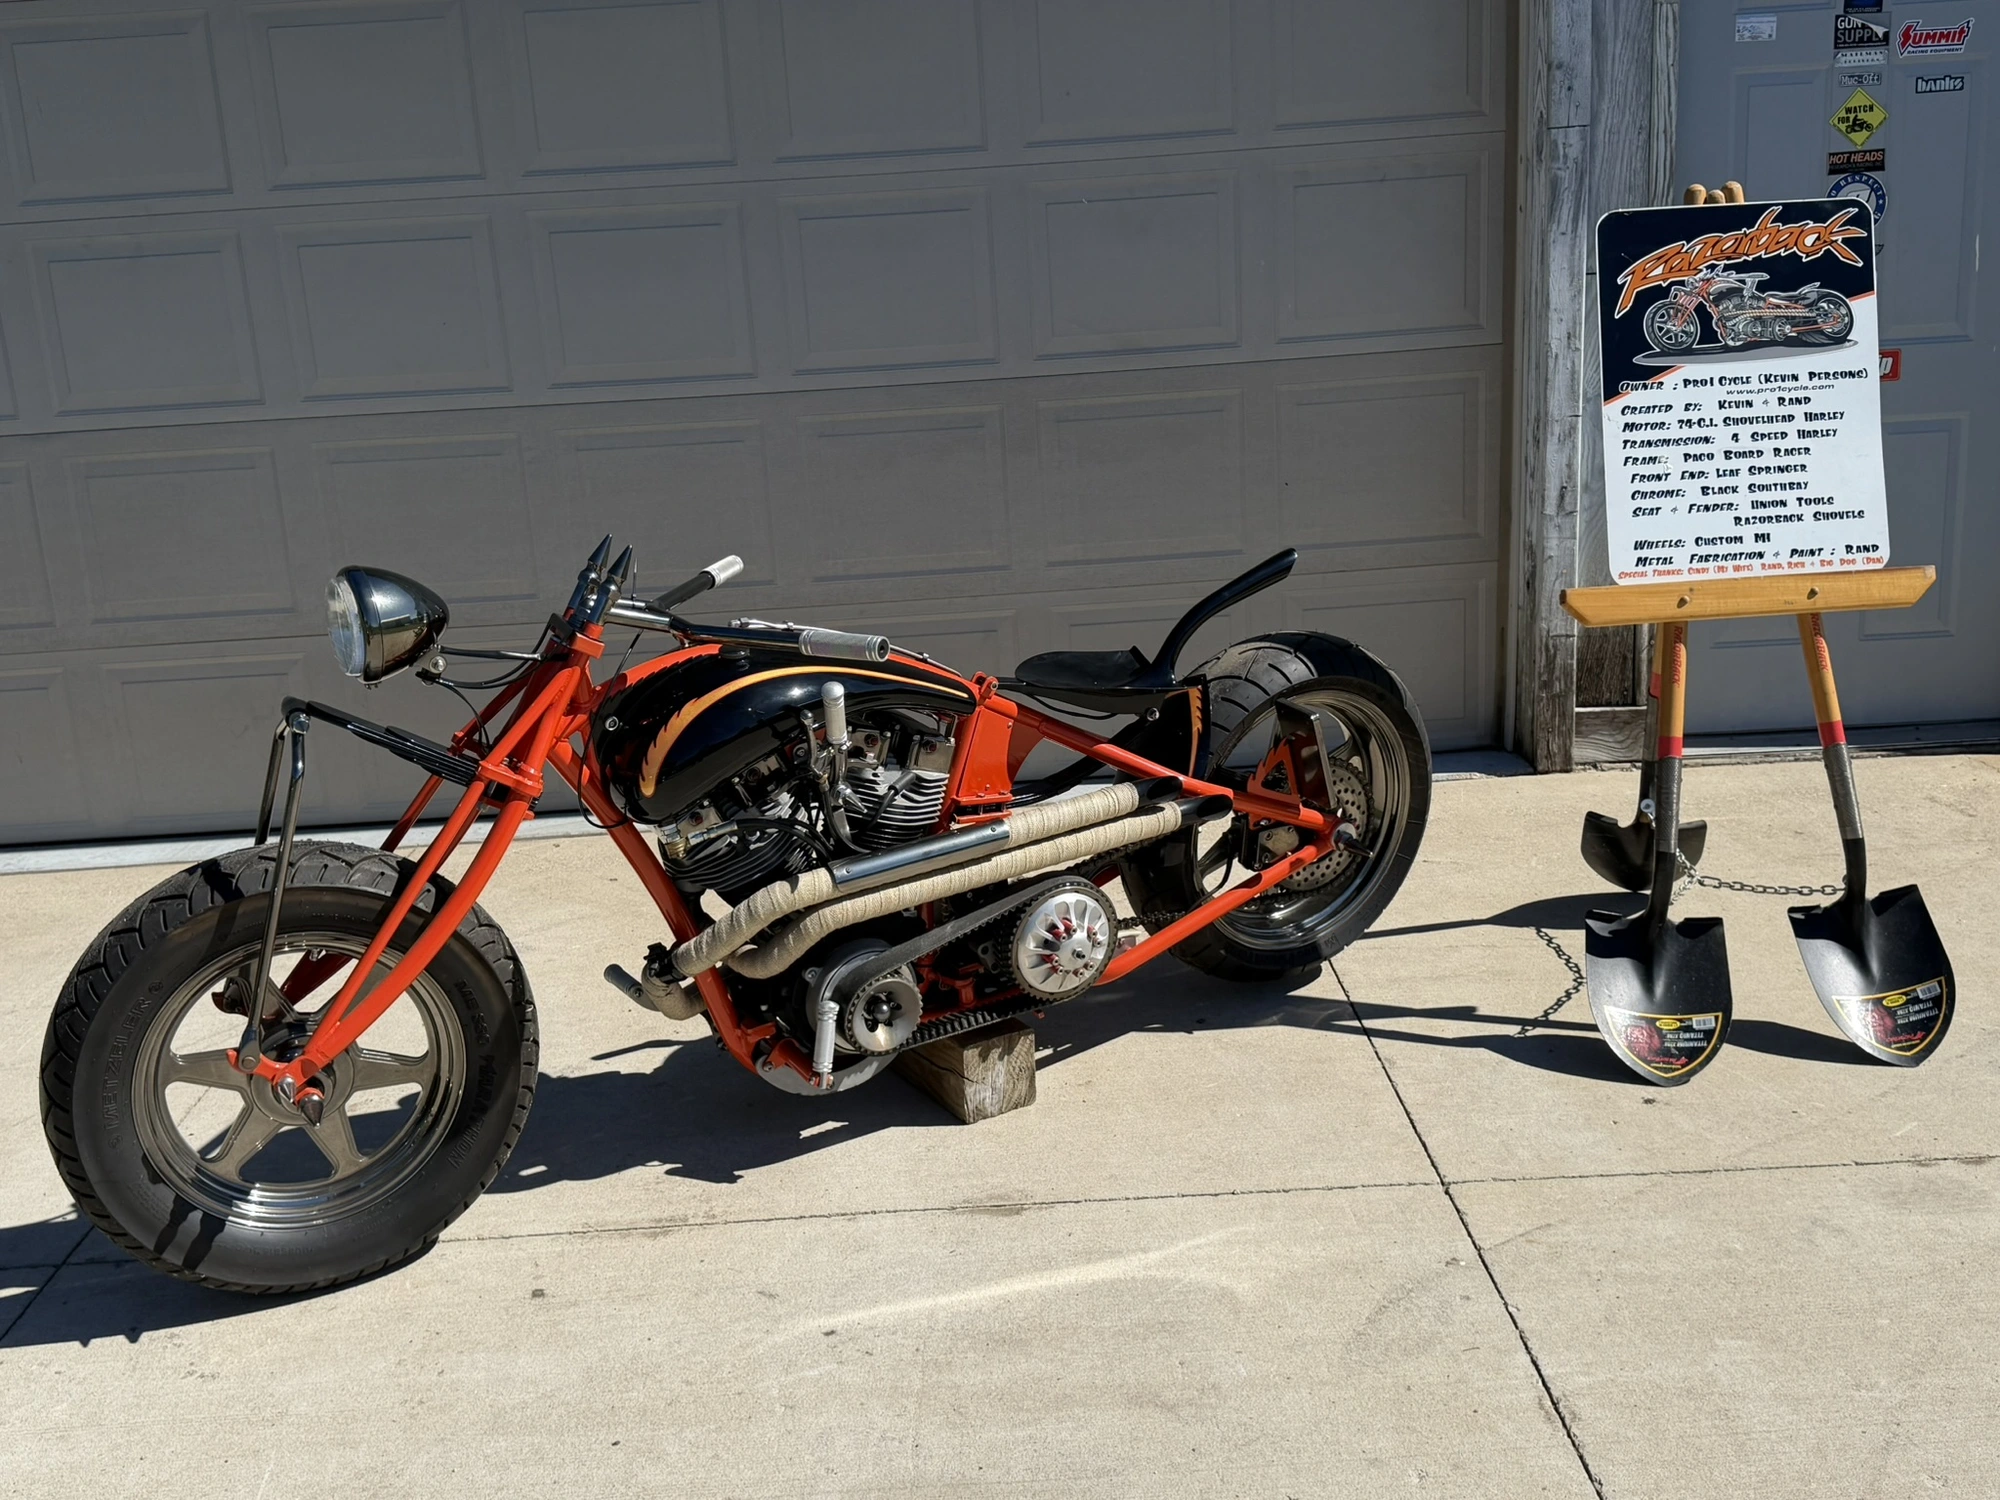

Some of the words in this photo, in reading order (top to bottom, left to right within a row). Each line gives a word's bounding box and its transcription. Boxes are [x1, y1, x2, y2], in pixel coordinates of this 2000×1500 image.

[1841, 74, 1880, 85] Muc-Off
[1837, 116, 1851, 124] FOR
[1844, 104, 1874, 115] WATCH
[1829, 153, 1850, 164] HOT
[1850, 151, 1884, 162] HEADS
[1840, 175, 1882, 196] RESPECT
[1620, 381, 1664, 393] OWNER
[1718, 375, 1752, 387] CYCLE
[1758, 373, 1799, 384] (KEVIN
[1808, 367, 1868, 382] PERSONS)
[1726, 384, 1835, 395] www.pro1cycle.com
[1621, 404, 1673, 416] CREATED
[1684, 402, 1702, 412] BY:
[1718, 399, 1754, 410] KEVIN
[1777, 396, 1812, 407] RAND
[1622, 421, 1671, 433] MOTOR:
[1722, 413, 1795, 427] SHOVELHEAD
[1804, 411, 1845, 422] HARLEY
[1622, 435, 1715, 450] TRANSMISSION:
[1731, 432, 1740, 443] 4
[1750, 431, 1788, 442] SPEED
[1797, 428, 1838, 440] HARLEY
[1623, 455, 1669, 467] FRAME:
[1683, 452, 1715, 463] PACO
[1723, 449, 1764, 461] BOARD
[1773, 446, 1812, 458] RACER
[1631, 472, 1671, 484] FRONT
[1680, 470, 1710, 481] END:
[1715, 467, 1741, 479] LEAF
[1748, 463, 1808, 476] SPRINGER
[1631, 488, 1686, 501] CHROME:
[1700, 485, 1740, 497] BLACK
[1747, 480, 1809, 494] SOUTHBAY
[1632, 506, 1662, 518] SEAT
[1688, 502, 1740, 514] FENDER:
[1750, 499, 1788, 510] UNION
[1796, 496, 1835, 507] TOOLS
[1733, 513, 1805, 527] RAZORBACK
[1812, 509, 1865, 521] SHOVELS
[1633, 539, 1686, 551] WHEELS:
[1694, 535, 1743, 548] CUSTOM
[1635, 556, 1674, 568] METAL
[1689, 550, 1766, 565] FABRICATION
[1789, 547, 1824, 559] PAINT
[1844, 544, 1880, 555] RAND
[1618, 570, 1648, 580] SPECIAL
[1652, 568, 1684, 577] THANKS:
[1687, 566, 1710, 575] CINDY
[1760, 562, 1785, 571] RAND,
[1787, 560, 1806, 570] RICH
[1820, 559, 1834, 568] BIG
[1839, 557, 1857, 567] DOG
[102, 996, 152, 1130] METZELER
